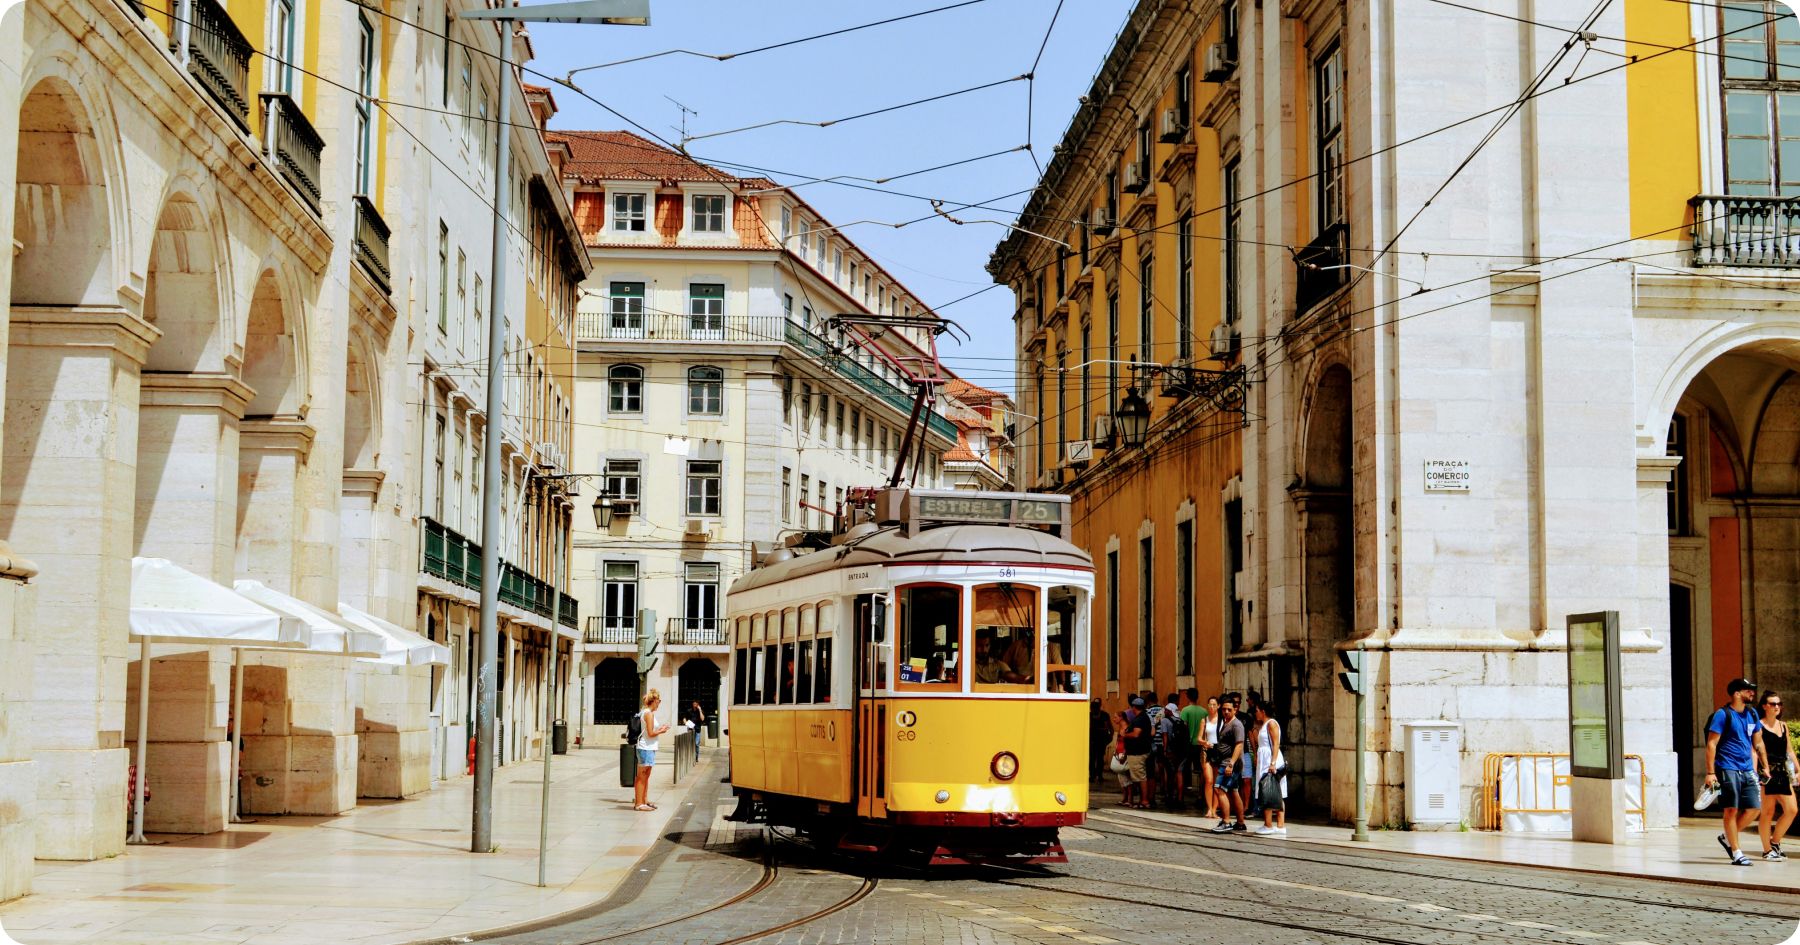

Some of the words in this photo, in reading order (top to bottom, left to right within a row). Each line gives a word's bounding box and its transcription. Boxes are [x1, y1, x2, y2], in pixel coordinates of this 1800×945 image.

[1426, 472, 1469, 480] COMERCIO
[924, 498, 1004, 514] ESTRELA
[1021, 501, 1048, 519] 25
[999, 568, 1016, 578] 581
